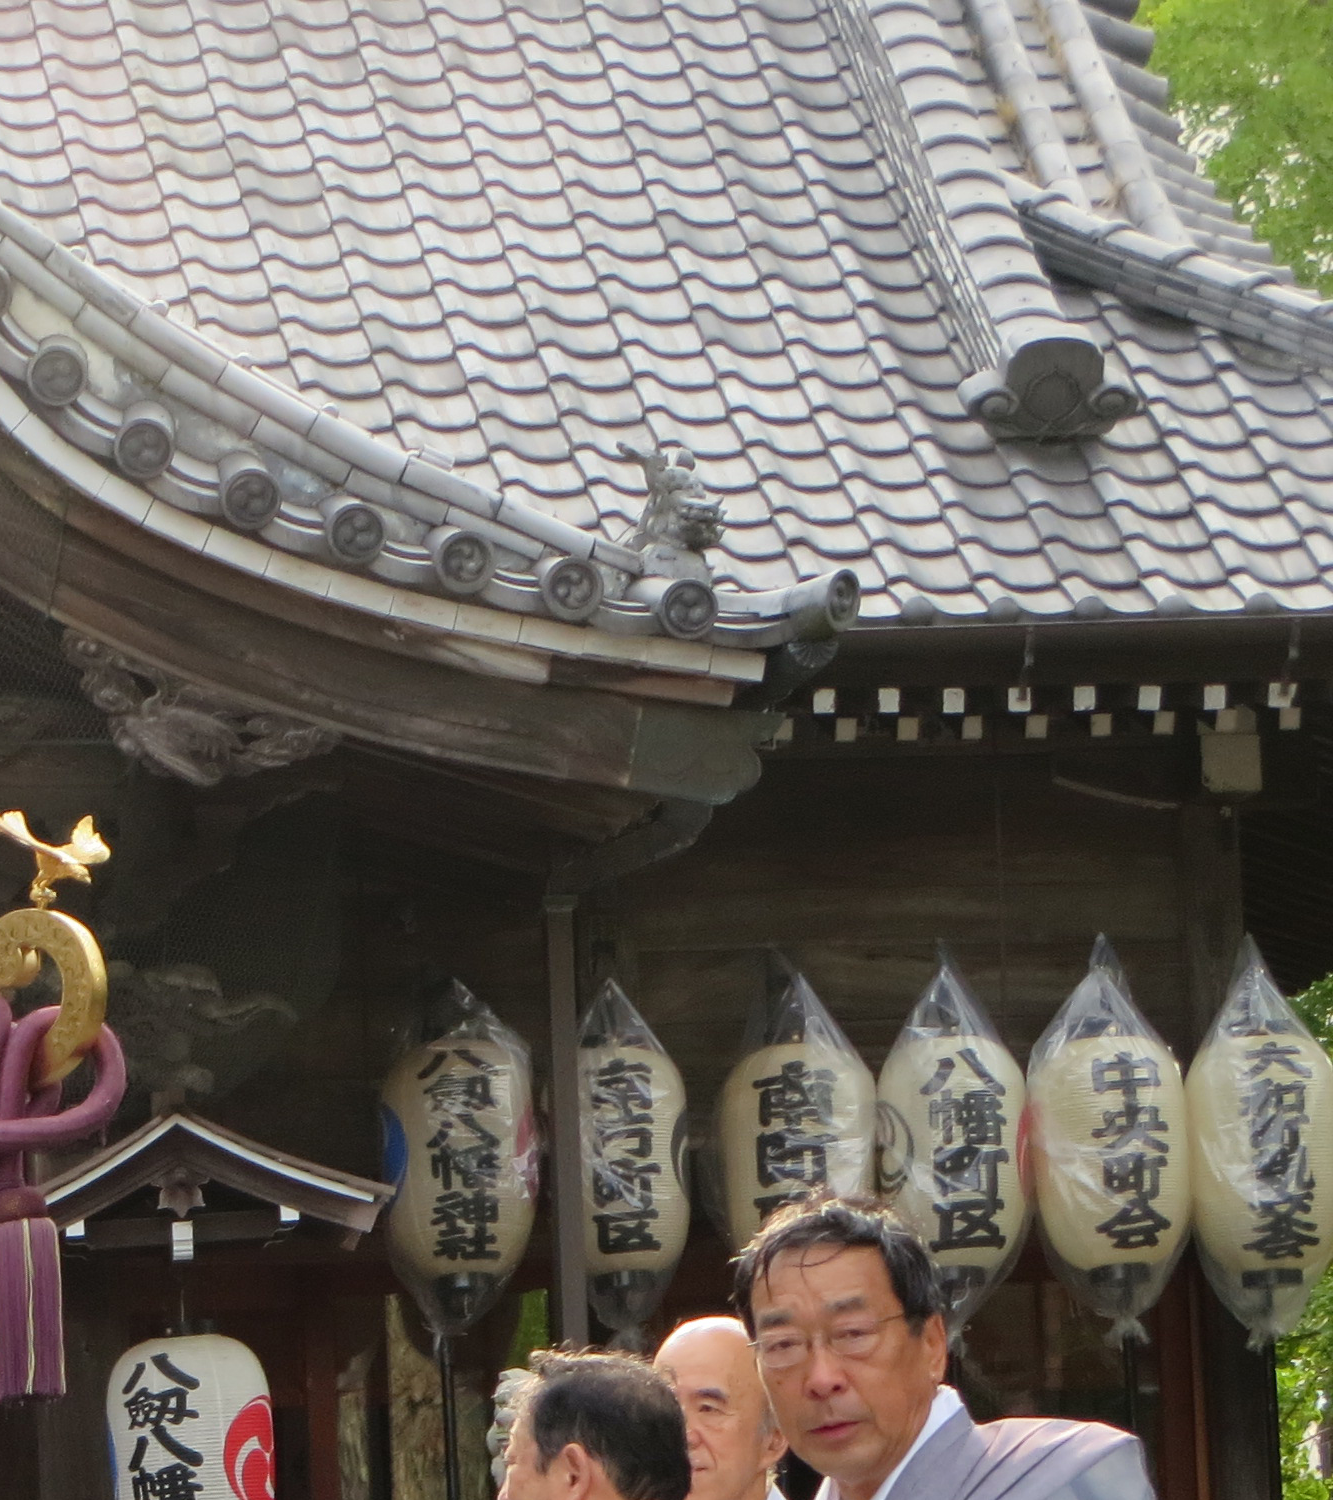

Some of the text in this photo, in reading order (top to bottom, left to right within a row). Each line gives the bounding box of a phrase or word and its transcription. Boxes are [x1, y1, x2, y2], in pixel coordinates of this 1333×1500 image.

[752, 1060, 837, 1220] 南町
[918, 1047, 1010, 1250] 八幡町区
[1091, 1052, 1171, 1248] 中央町会
